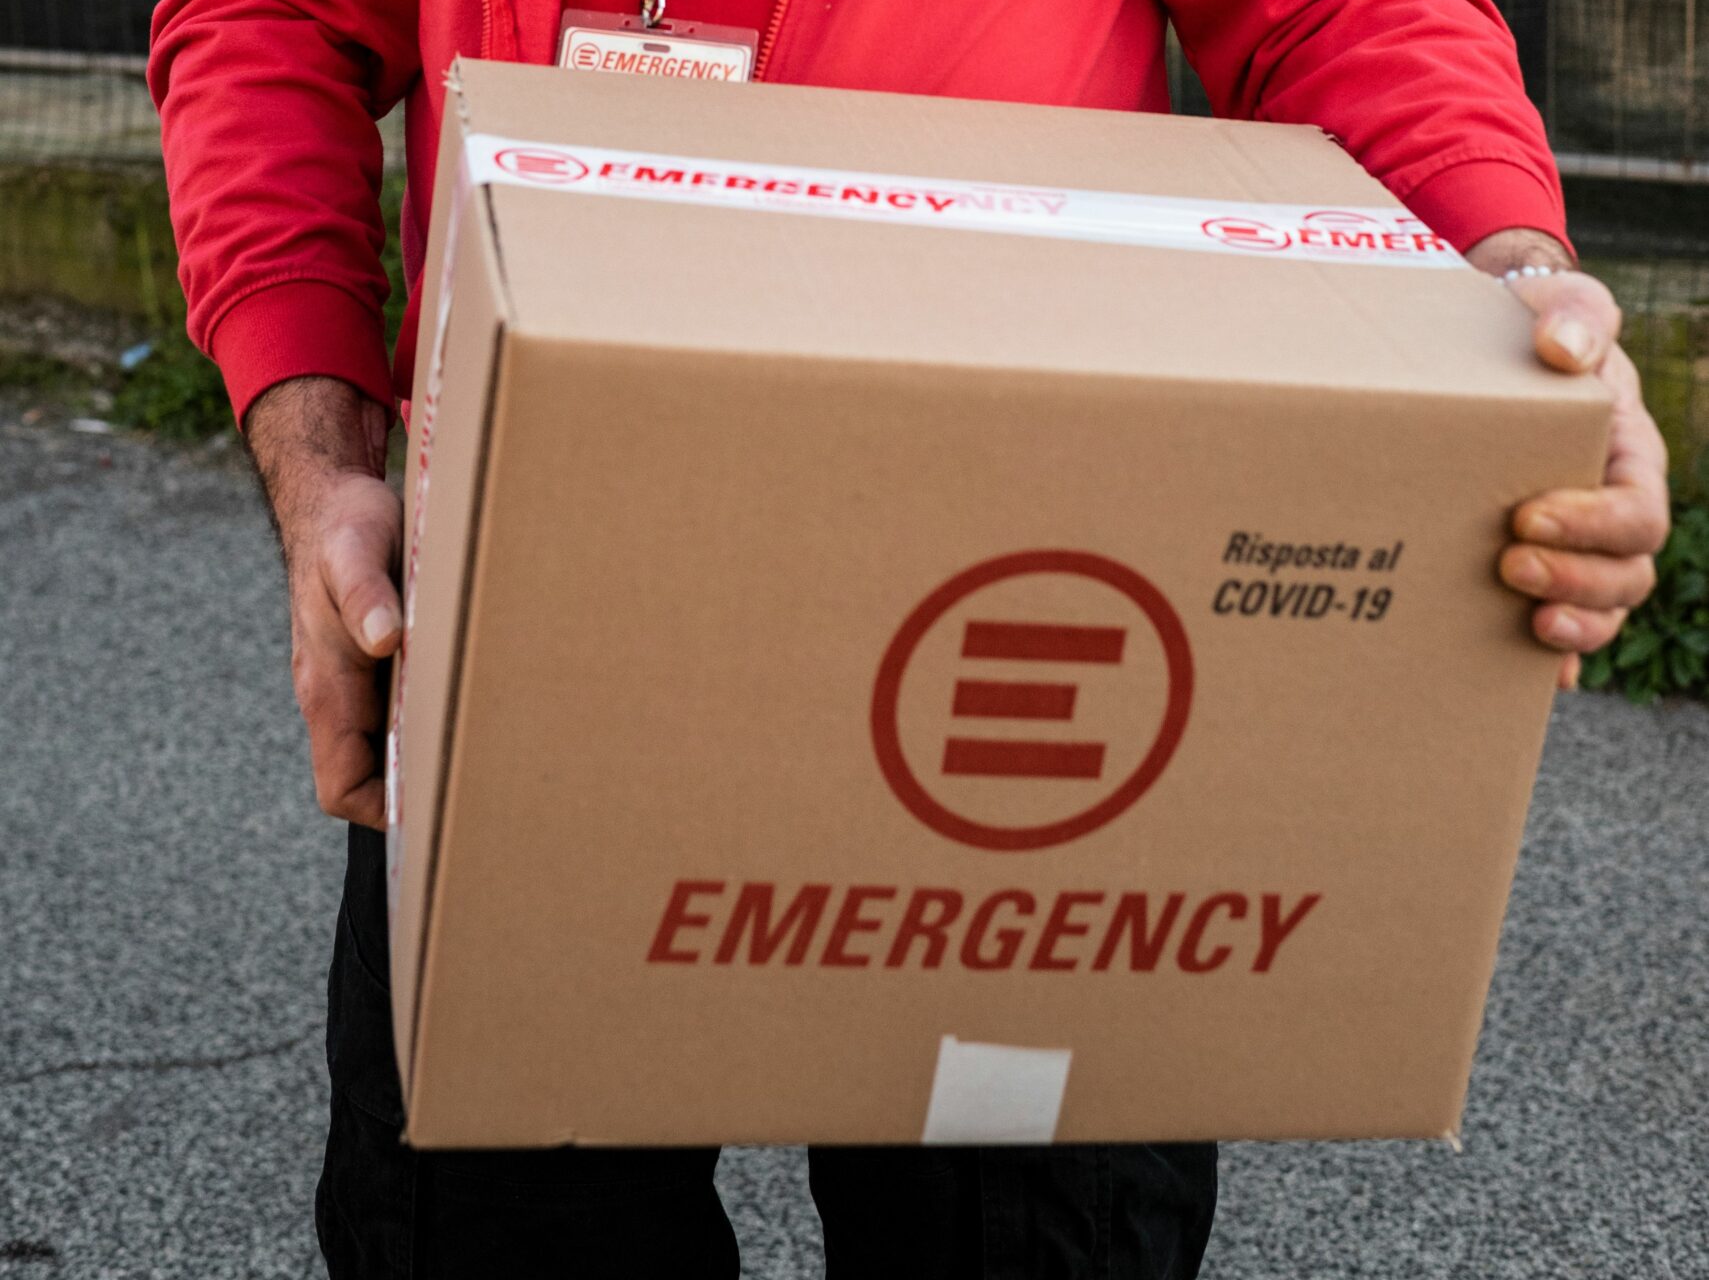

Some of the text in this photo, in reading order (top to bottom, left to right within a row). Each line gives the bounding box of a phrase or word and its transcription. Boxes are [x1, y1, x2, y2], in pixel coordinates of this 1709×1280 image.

[602, 50, 737, 81] EMERGENCY
[1221, 530, 1404, 575] Risposta al
[1211, 579, 1393, 622] COVID-19
[645, 879, 1322, 975] EMERGENCY
